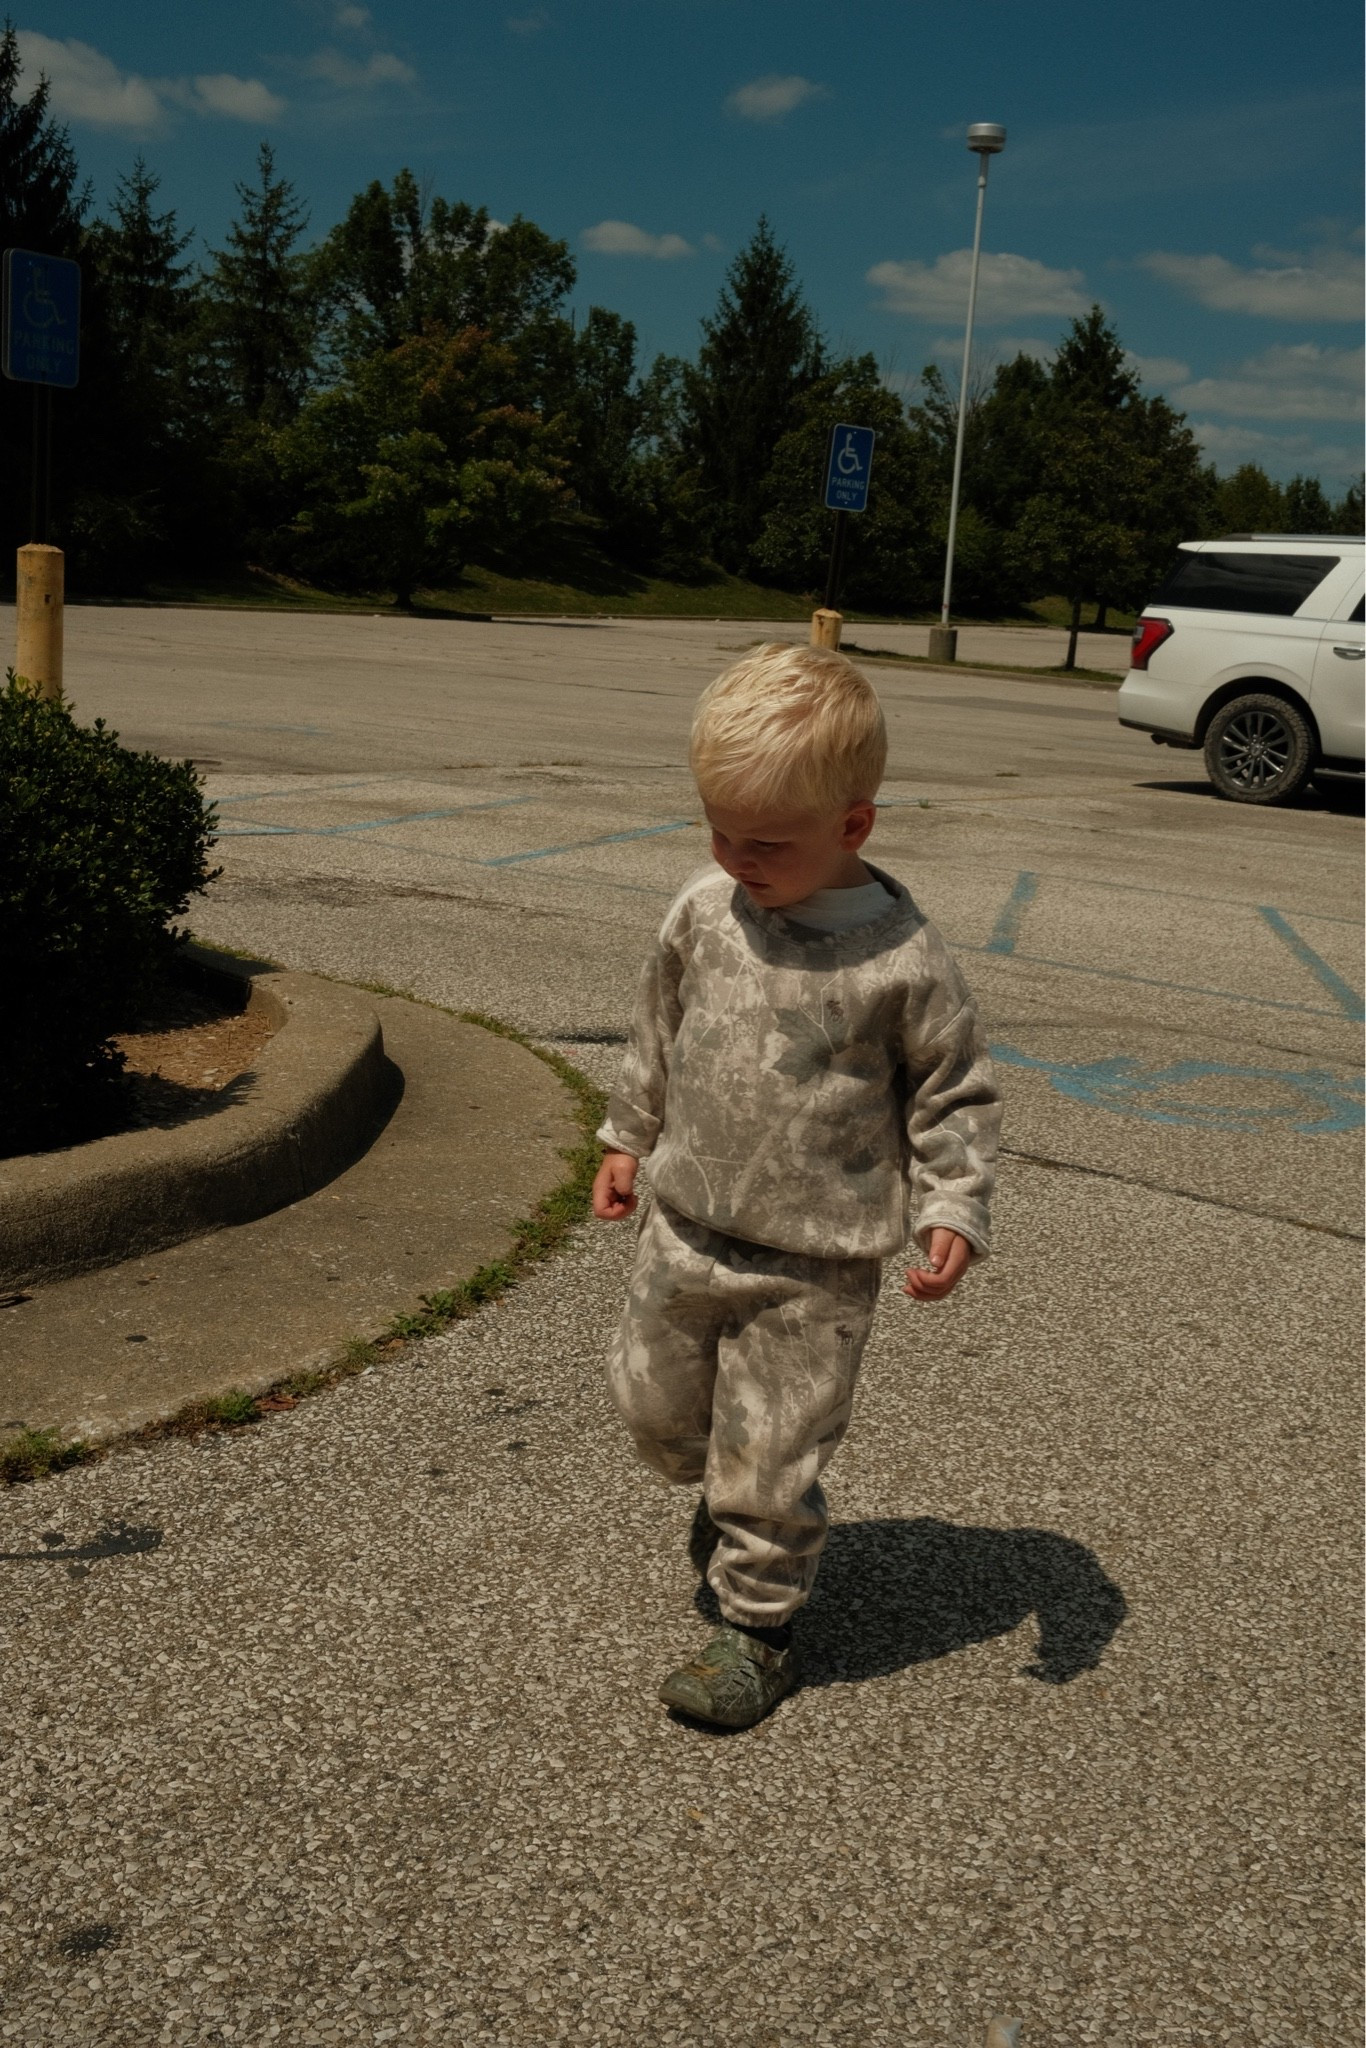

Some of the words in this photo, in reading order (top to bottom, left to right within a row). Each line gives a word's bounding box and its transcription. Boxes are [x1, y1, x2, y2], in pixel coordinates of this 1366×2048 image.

[14, 330, 74, 354] PARKING
[26, 354, 62, 373] ONLY
[831, 477, 865, 490] PARKING
[836, 490, 858, 501] ONLY
